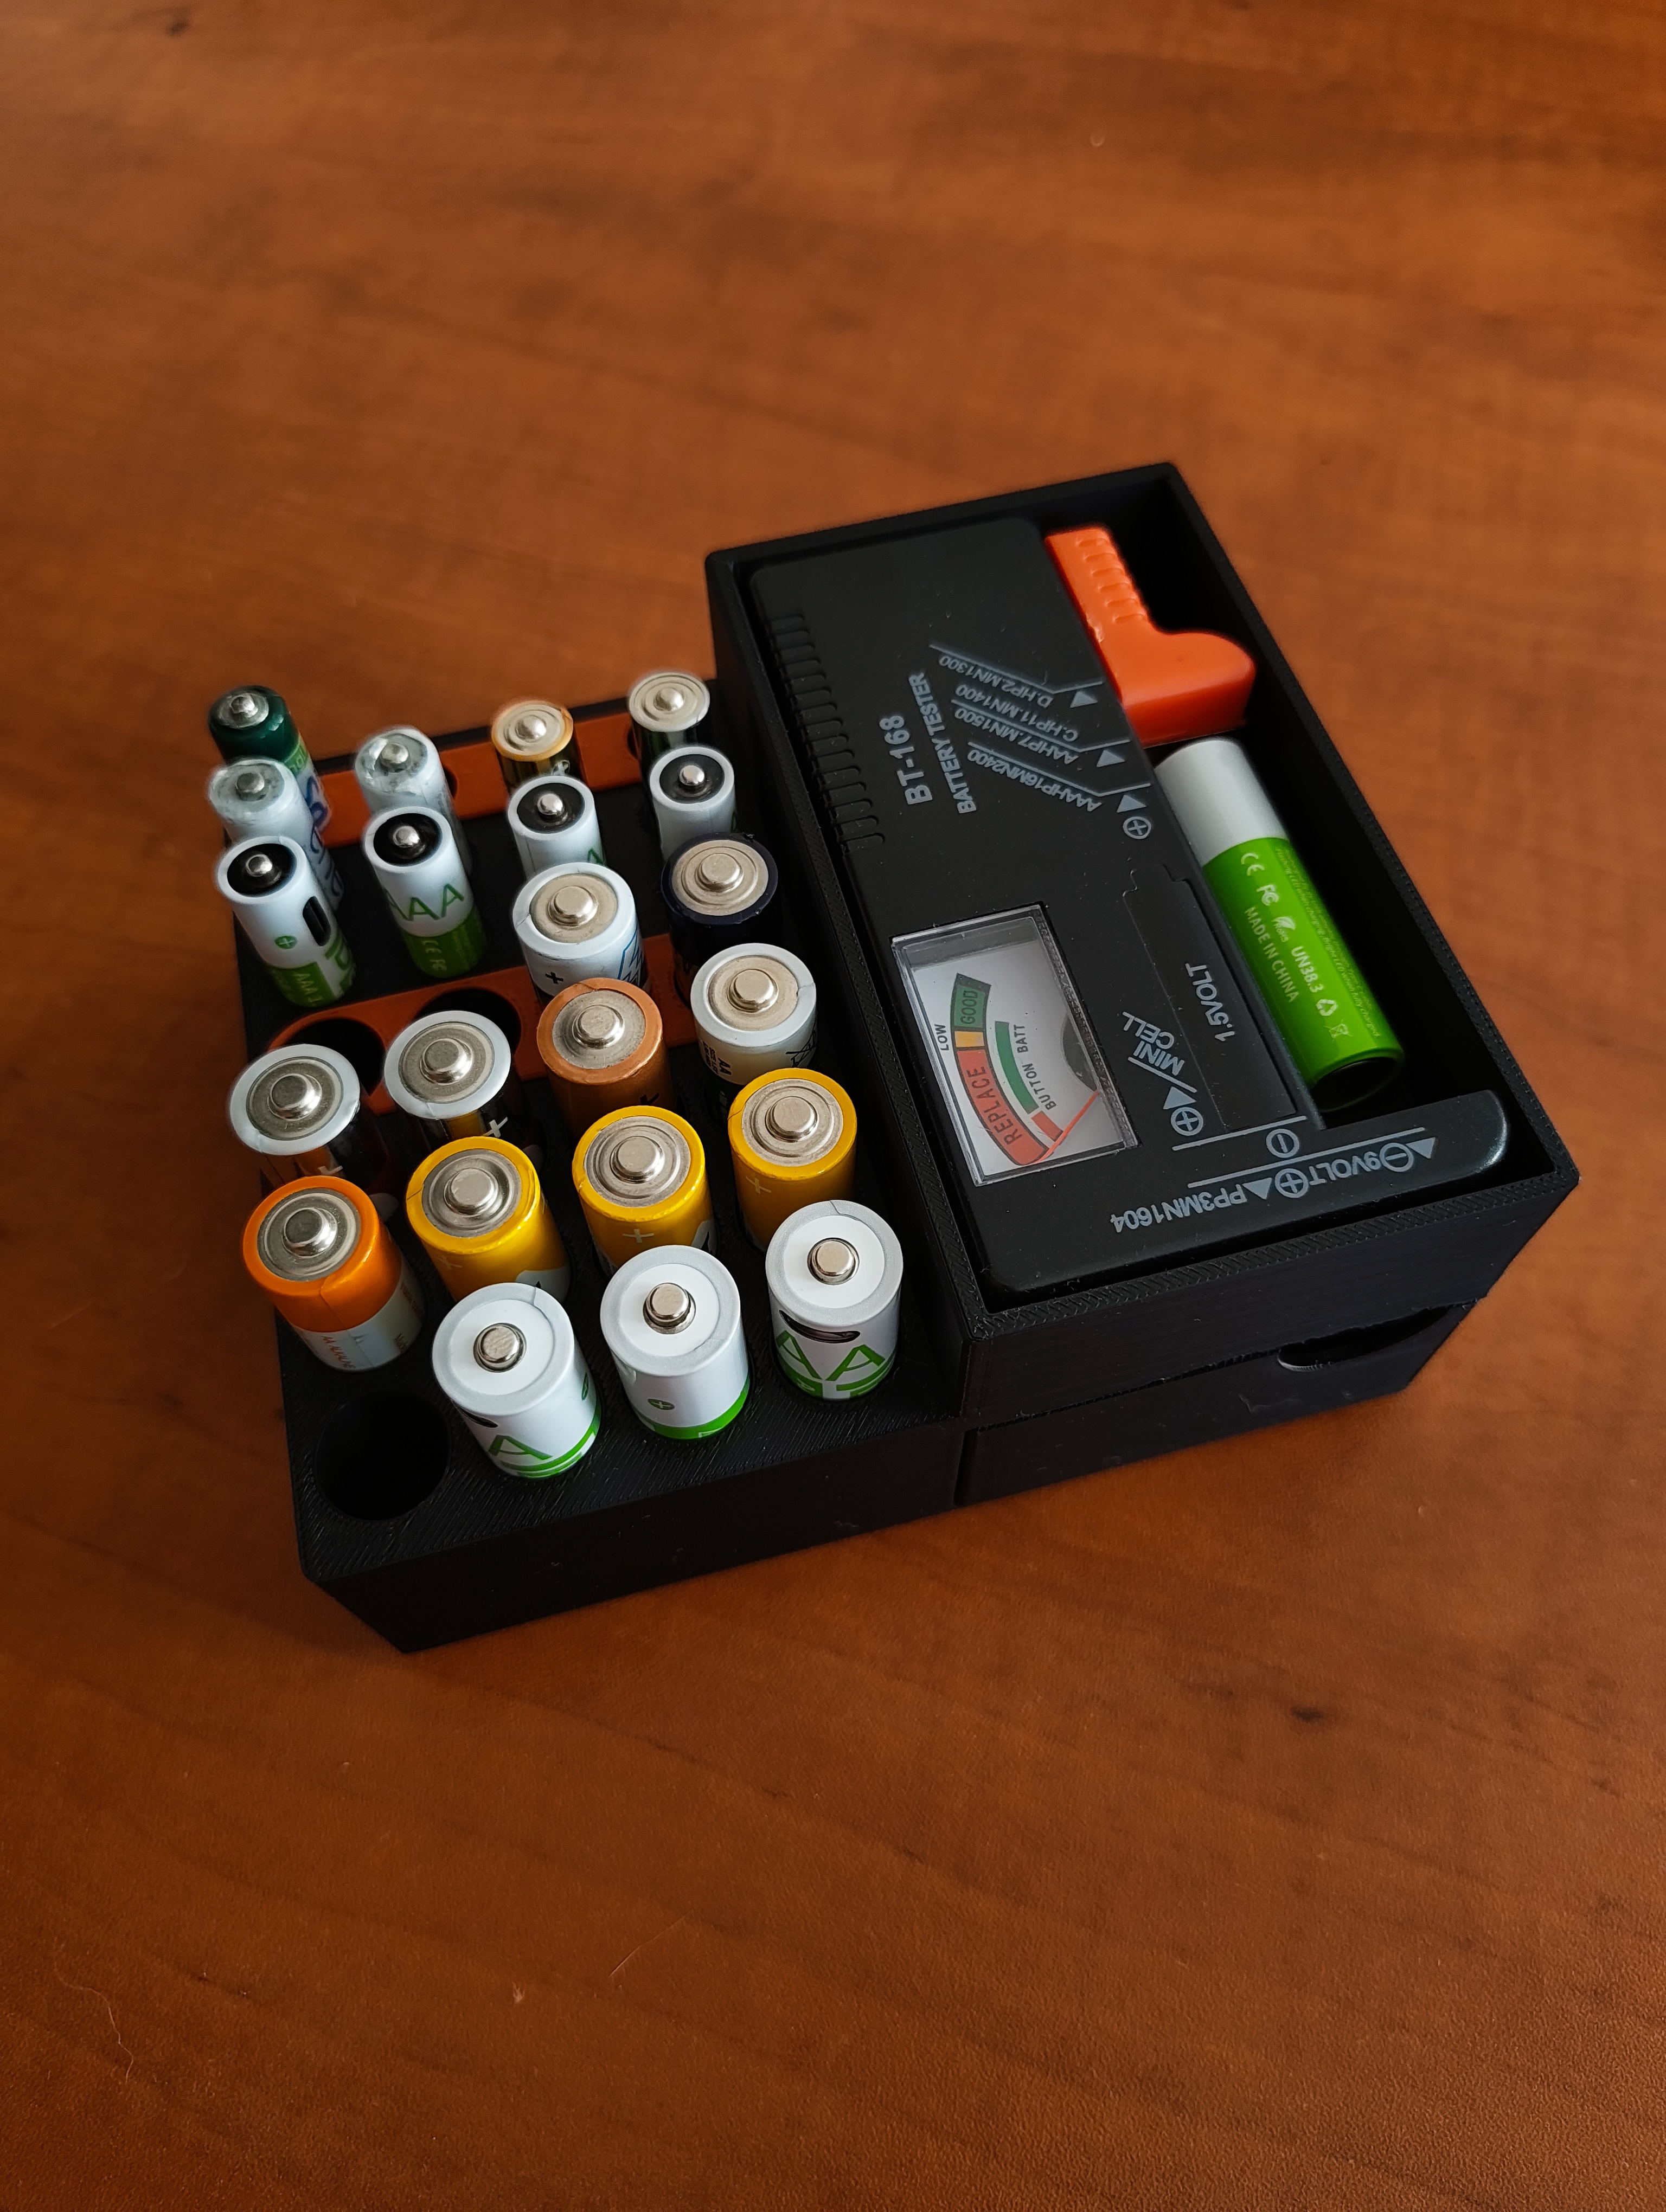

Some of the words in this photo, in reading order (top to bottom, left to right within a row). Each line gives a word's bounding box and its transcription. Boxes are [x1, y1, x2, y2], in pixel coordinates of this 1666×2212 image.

[909, 672, 945, 736] TESTER
[879, 716, 933, 805] BT-168
[932, 737, 977, 814] BATTERY
[1244, 906, 1271, 944] MADE
[1263, 942, 1280, 959] IN
[1272, 960, 1299, 1002] CHINA
[1291, 946, 1324, 993] UN38.3
[960, 990, 978, 1025] GOOD
[1185, 963, 1235, 1041] 1.5VOLT
[934, 1024, 950, 1051] LOW
[1013, 1024, 1029, 1053] BATT
[1122, 1011, 1175, 1050] CELL
[1133, 1040, 1185, 1076] MINI
[966, 1066, 1022, 1145] REPLACE
[1022, 1063, 1057, 1110] BUTTON
[1309, 1151, 1381, 1186] 9VOLT
[1110, 1184, 1247, 1233] PP3MN1604
[776, 1330, 886, 1381] AA
